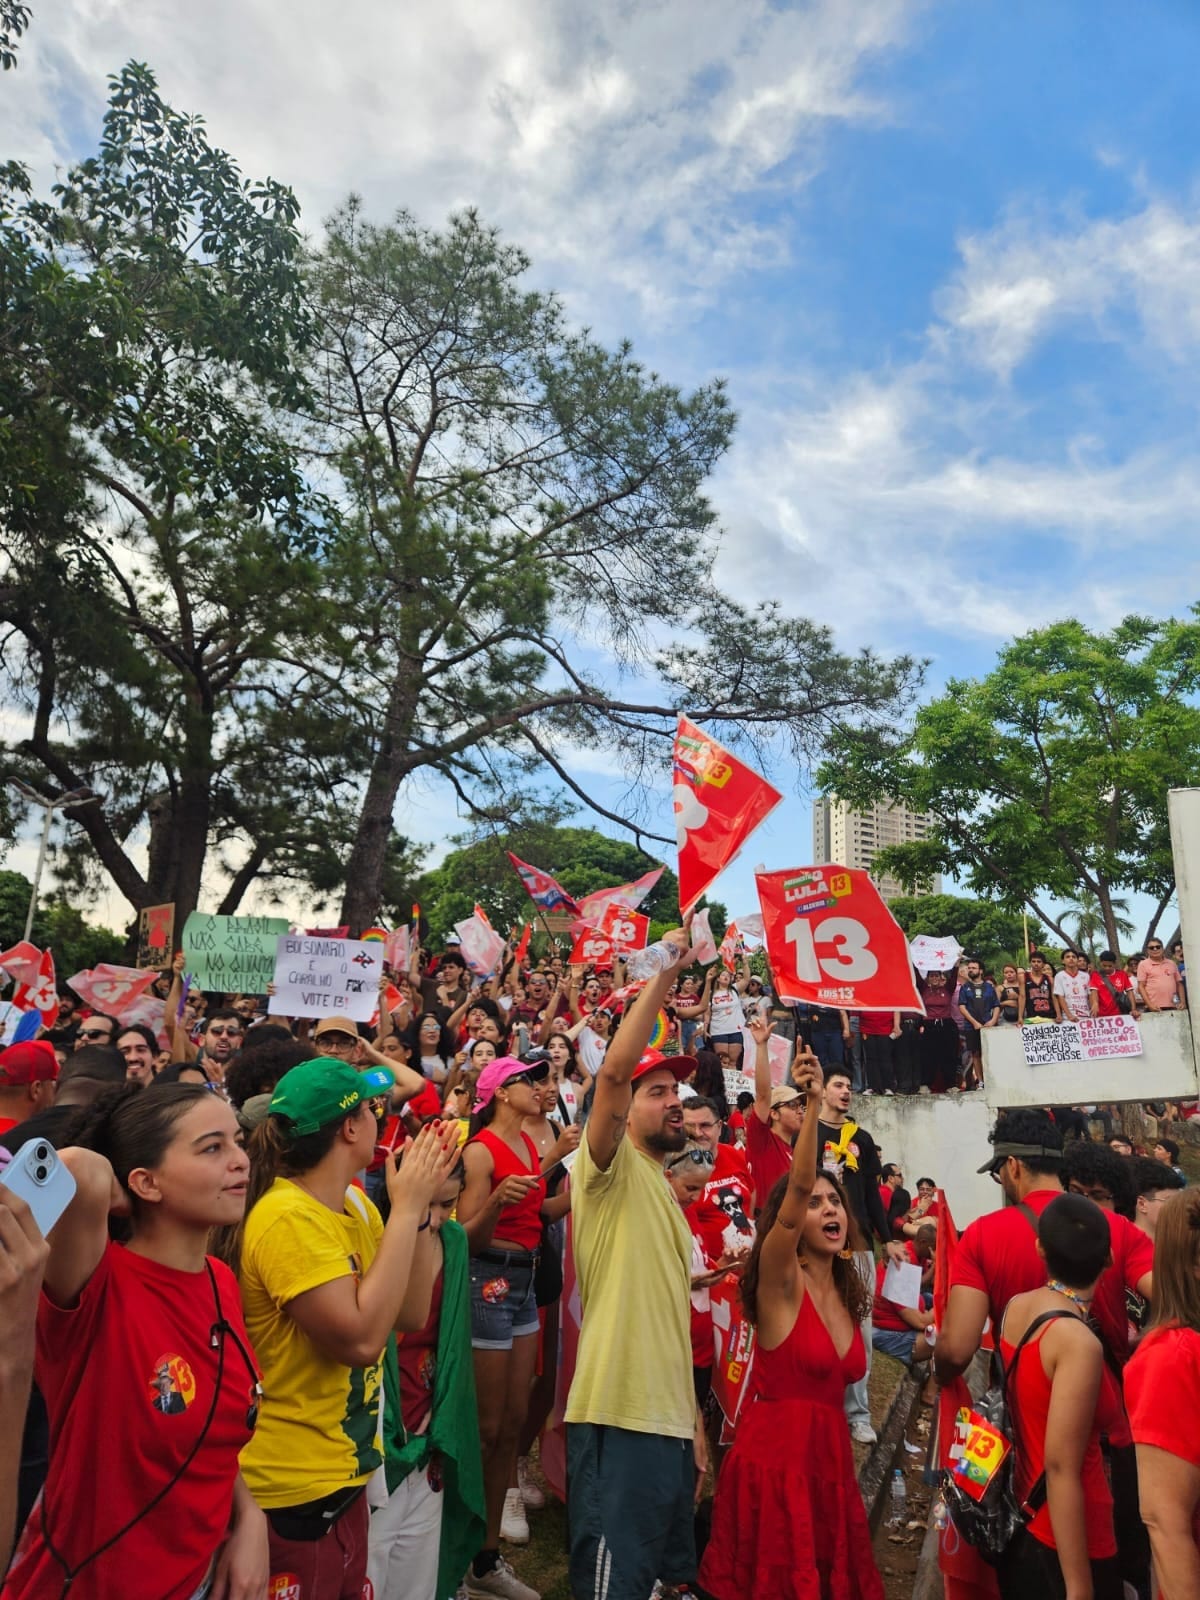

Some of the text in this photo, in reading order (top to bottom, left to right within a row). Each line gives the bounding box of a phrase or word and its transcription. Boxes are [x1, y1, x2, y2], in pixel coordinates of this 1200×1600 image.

[785, 880, 829, 903] LULA
[832, 876, 847, 892] 13
[206, 914, 278, 935] O BRASIL
[612, 919, 637, 942] 13
[189, 930, 264, 954] NÃO CABE
[286, 940, 345, 958] BOLSONARO
[785, 916, 878, 984] 13
[206, 952, 274, 974] NO QUINTA
[308, 960, 347, 974] E O
[288, 970, 333, 987] CARALHO
[302, 992, 330, 1007] VOTE
[1021, 1025, 1060, 1036] Cuidado
[1079, 1017, 1124, 1030] CRISTO
[1081, 1027, 1119, 1038] DEFENDEU
[1123, 1026, 1135, 1034] OS
[1026, 1050, 1081, 1063] NUNCA DISSE
[1046, 1042, 1071, 1054] DEUS
[339, 1091, 359, 1109] vivo
[170, 1360, 193, 1392] 13
[967, 1431, 996, 1458] 13
